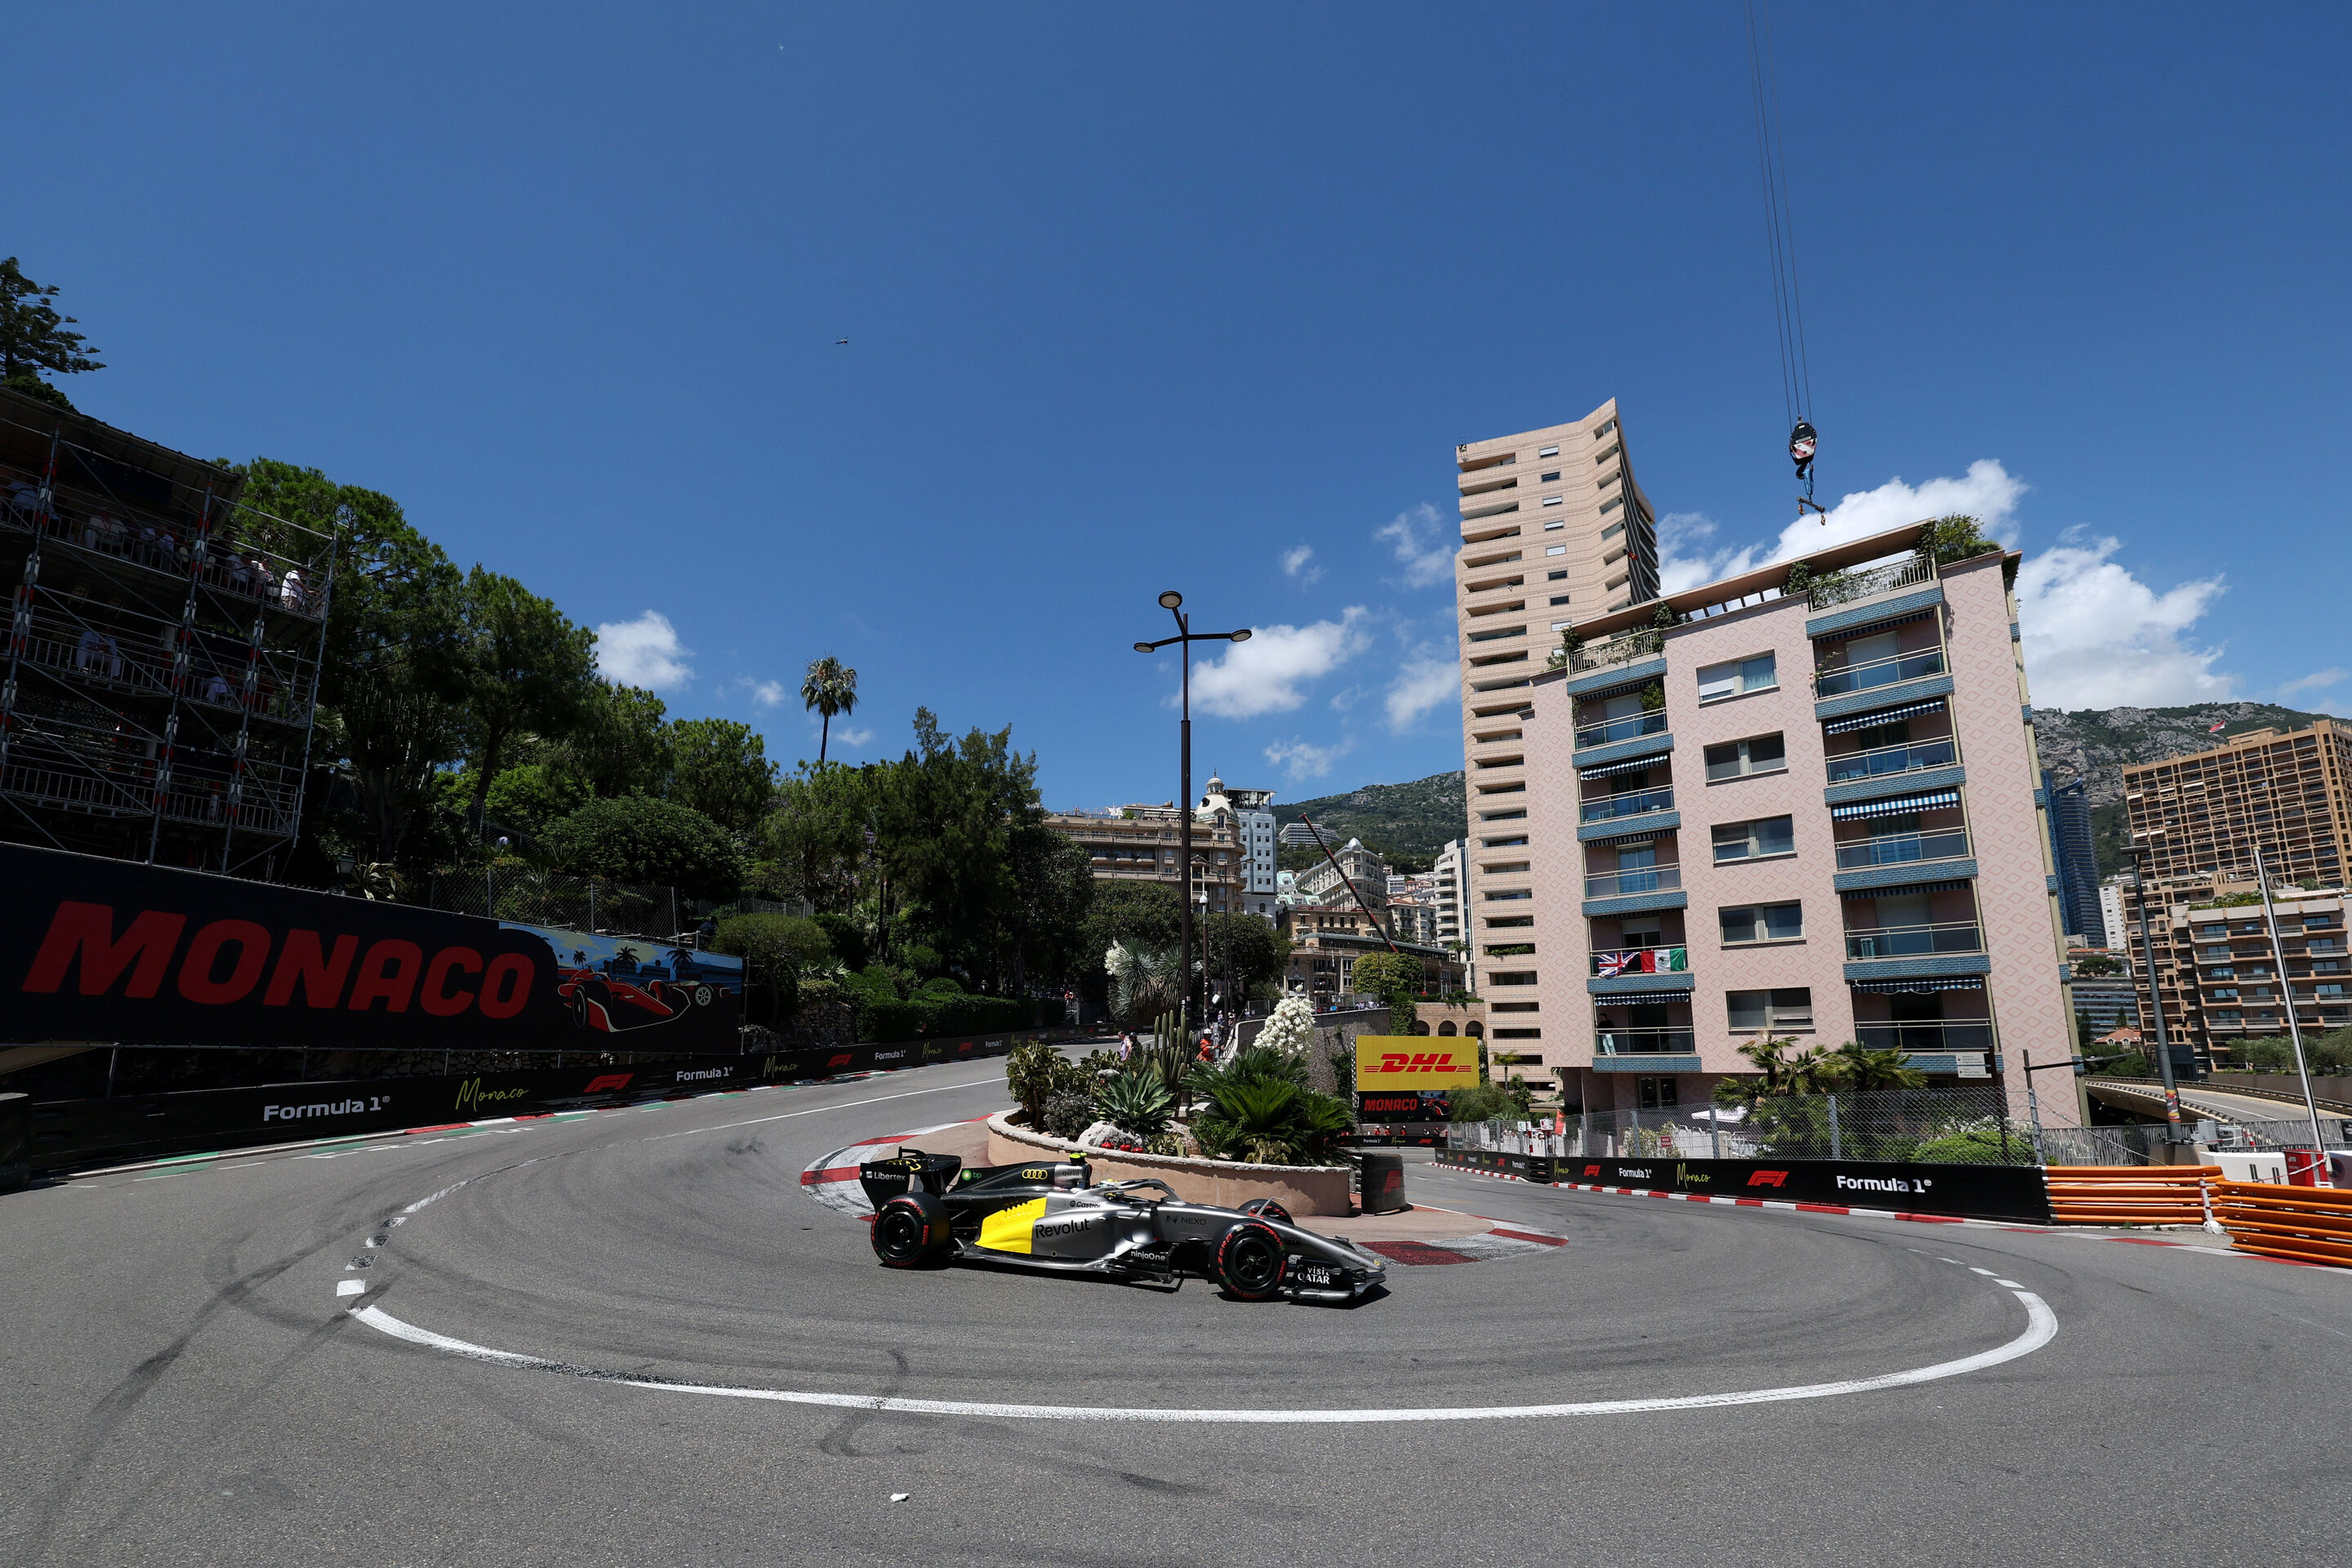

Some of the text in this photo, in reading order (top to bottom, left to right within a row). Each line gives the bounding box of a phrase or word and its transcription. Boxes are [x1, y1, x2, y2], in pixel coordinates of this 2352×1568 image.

[21, 901, 536, 1020] MONACO
[875, 1050, 898, 1061] Formula
[763, 1054, 800, 1079] Monaco
[1379, 1054, 1458, 1073] DHL
[676, 1068, 722, 1082] Formula
[455, 1077, 530, 1113] Monaco
[263, 1098, 365, 1122] Formula
[1364, 1098, 1419, 1111] MONACO
[874, 1171, 906, 1181] Libertex
[973, 1171, 982, 1179] bp
[1619, 1167, 1644, 1178] Formula
[1677, 1162, 1711, 1189] Monaco
[1836, 1175, 1909, 1193] Formula
[1181, 1217, 1206, 1225] NEXO
[1036, 1218, 1090, 1239] Revolut
[1130, 1250, 1166, 1262] ninjaOne
[1298, 1272, 1330, 1285] QATAR
